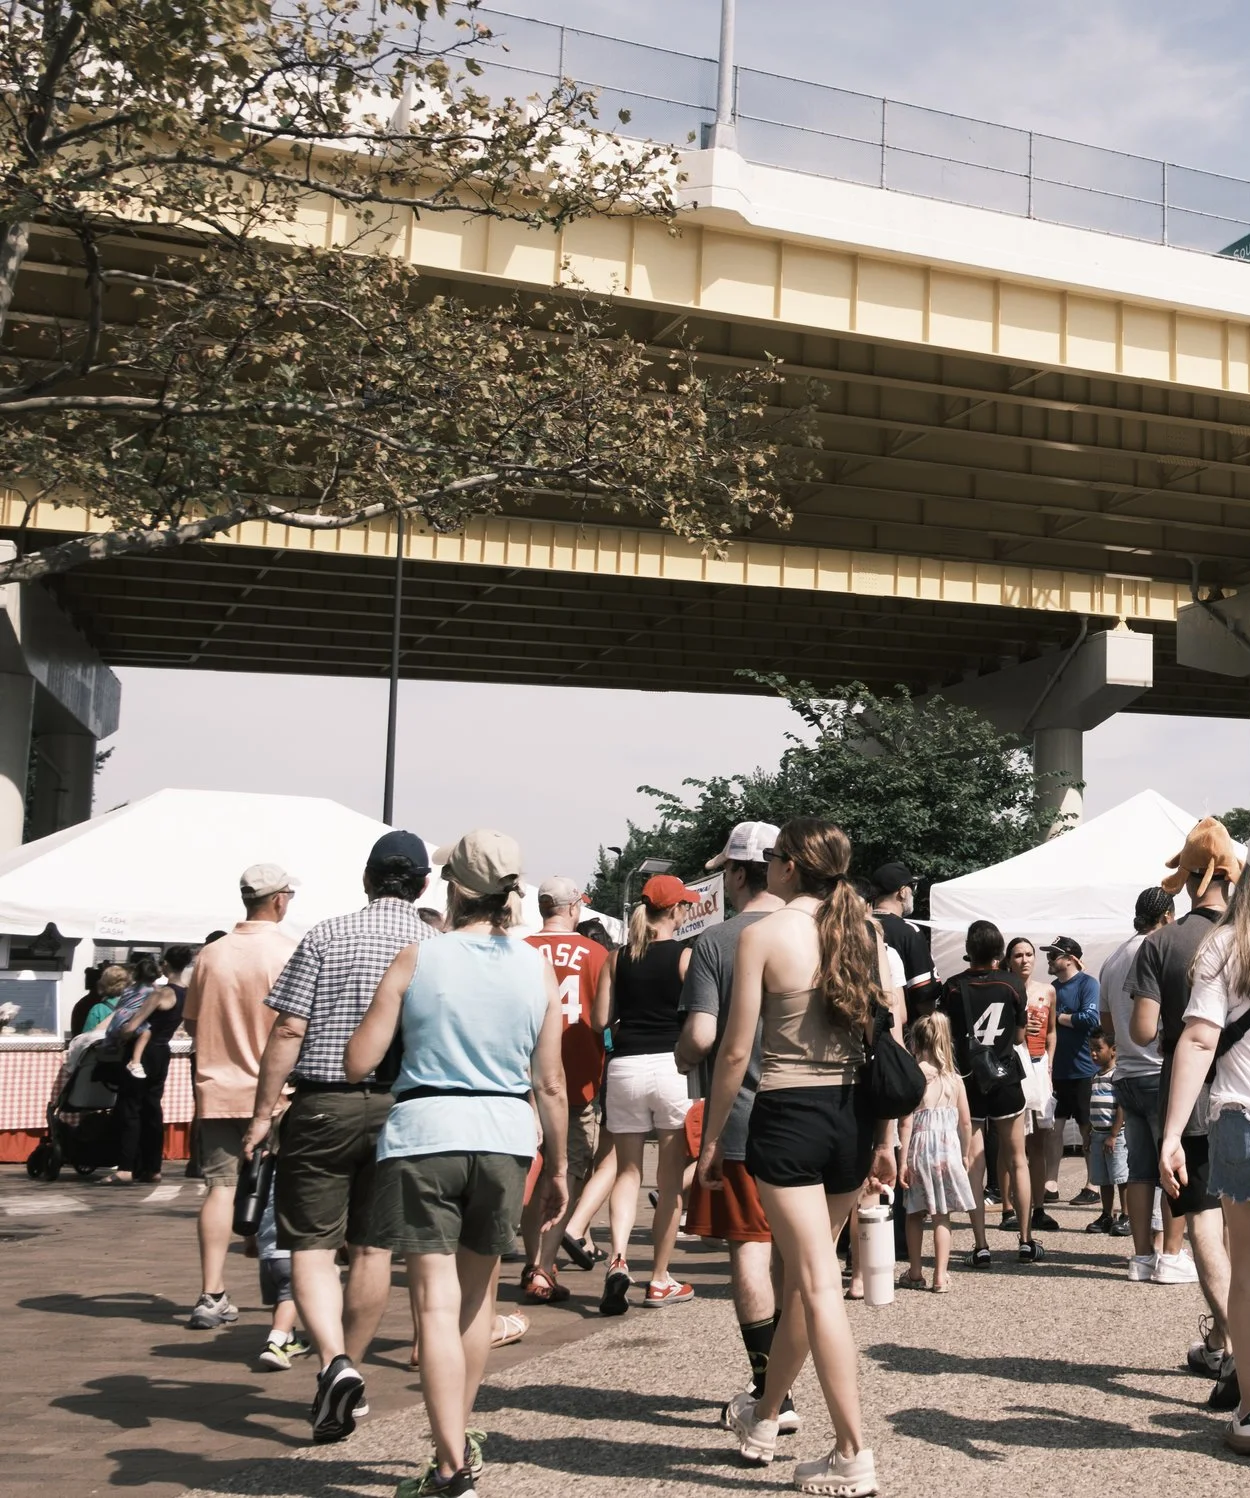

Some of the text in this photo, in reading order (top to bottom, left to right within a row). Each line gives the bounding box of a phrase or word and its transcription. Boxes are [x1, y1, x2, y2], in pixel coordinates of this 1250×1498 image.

[676, 919, 705, 936] FACTORY
[538, 943, 590, 971] OSE
[973, 1002, 1006, 1046] 4
